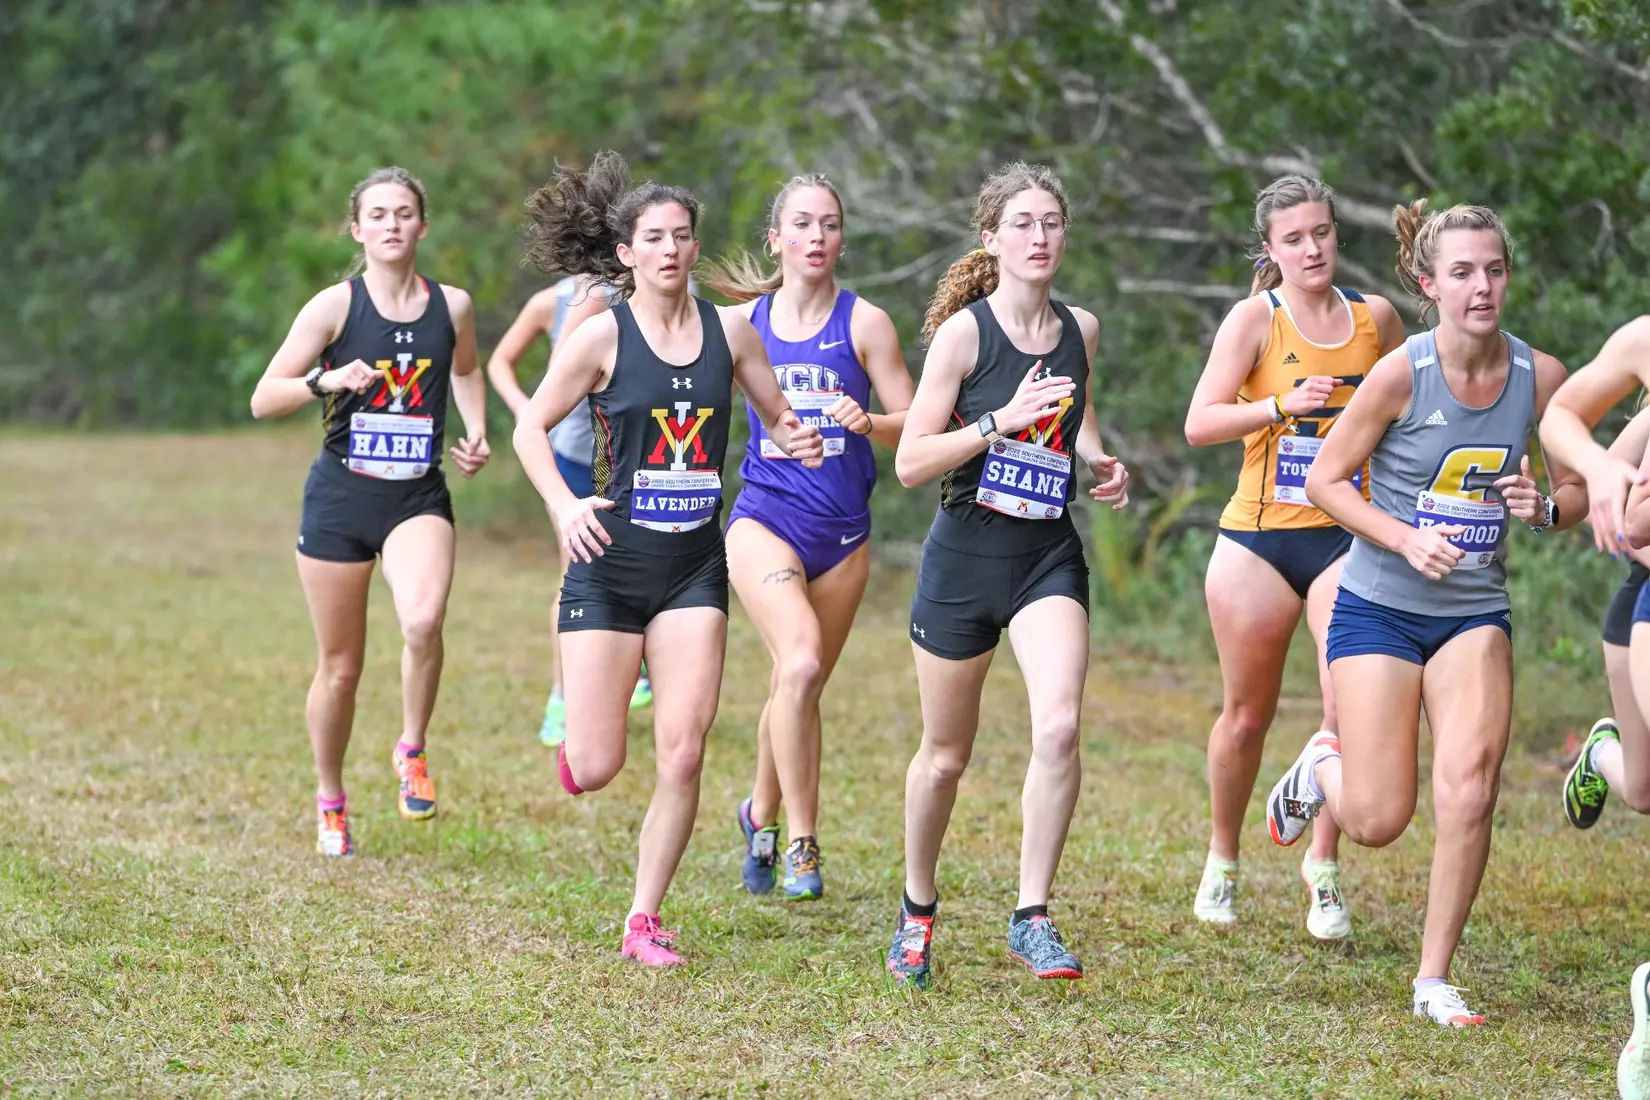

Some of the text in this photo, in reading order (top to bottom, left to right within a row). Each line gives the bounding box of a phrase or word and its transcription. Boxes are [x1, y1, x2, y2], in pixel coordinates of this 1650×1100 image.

[352, 433, 429, 459] HAHN
[1022, 450, 1046, 461] SOUTHERN
[986, 460, 1066, 499] SHANK
[635, 496, 716, 511] LAVENDER
[1451, 505, 1478, 514] SOUTHERN
